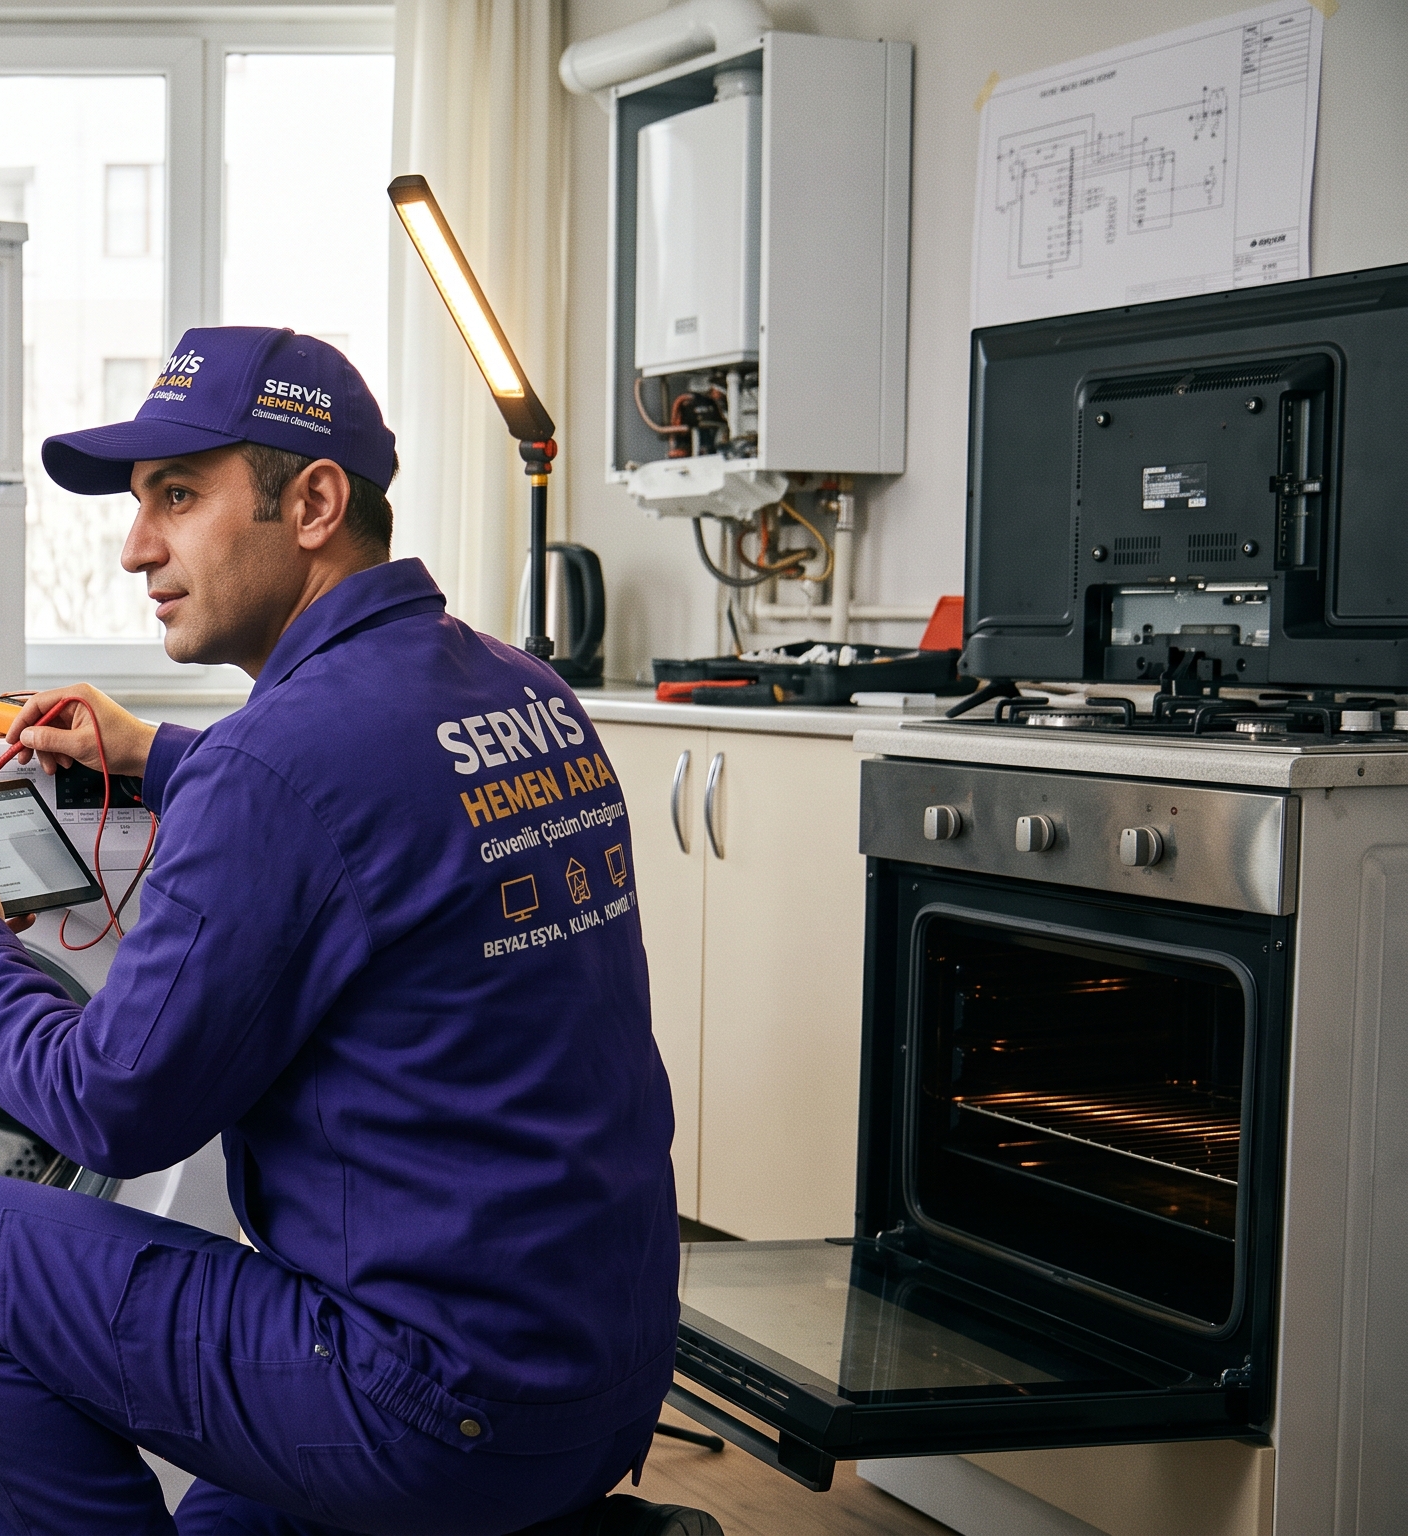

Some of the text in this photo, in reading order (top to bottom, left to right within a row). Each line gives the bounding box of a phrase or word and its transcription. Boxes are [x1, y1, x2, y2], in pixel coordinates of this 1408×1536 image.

[166, 374, 193, 389] ARA
[256, 394, 304, 414] HEMEN
[305, 406, 332, 423] ARA
[436, 686, 585, 775] SERVİS
[459, 753, 616, 828] HEMEN ARA
[480, 826, 541, 864] Güvenilir
[541, 816, 582, 848] Çözüm
[483, 932, 529, 958] BEYAZ
[529, 923, 568, 948] EŞYA,
